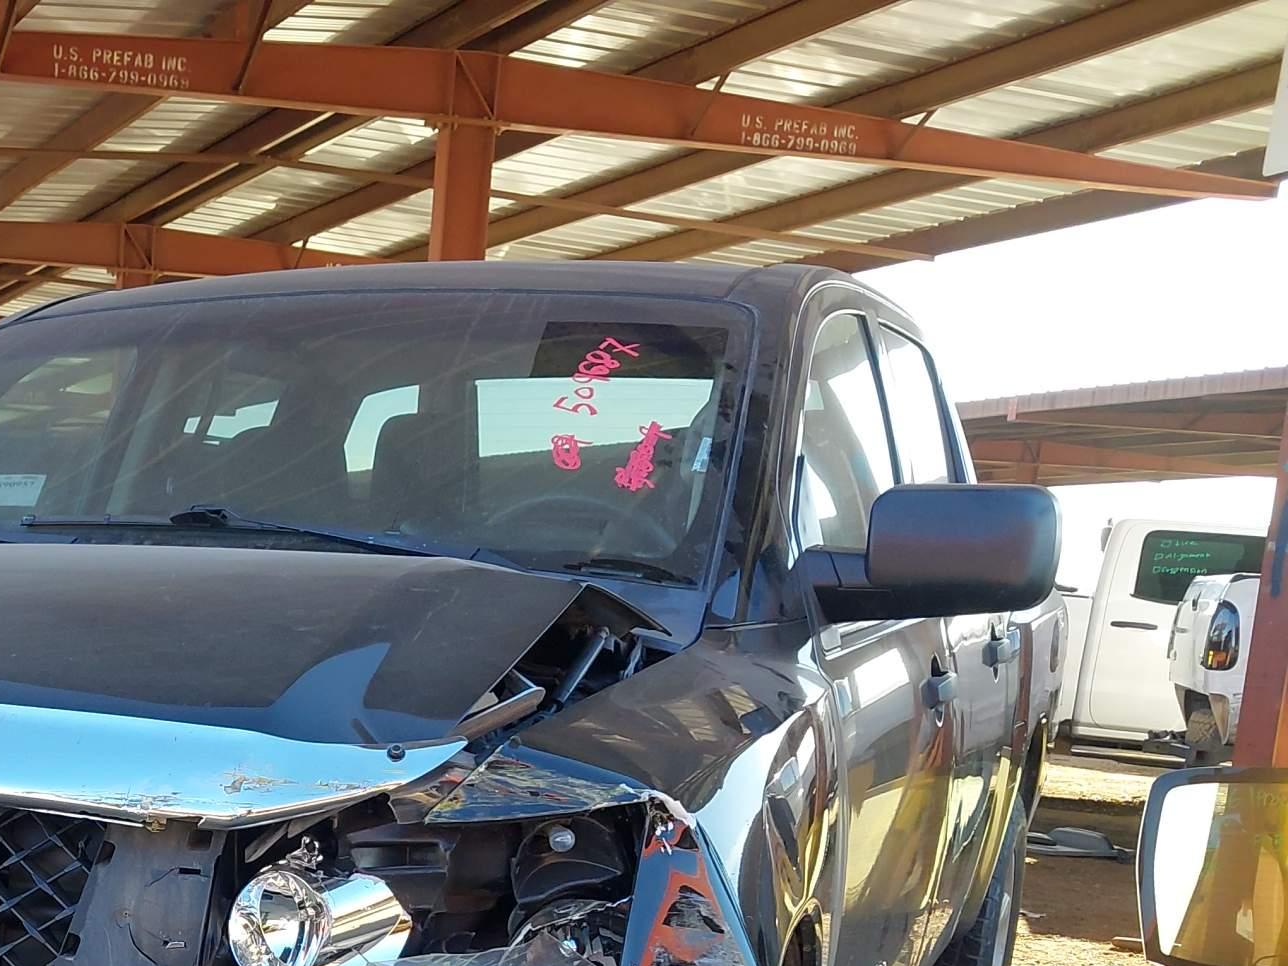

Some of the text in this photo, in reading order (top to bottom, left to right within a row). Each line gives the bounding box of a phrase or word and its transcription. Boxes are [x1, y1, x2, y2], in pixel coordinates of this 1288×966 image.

[53, 44, 83, 62] U.S.
[92, 48, 154, 69] PREFAB
[774, 118, 827, 136] PREFAB
[833, 124, 860, 140] INC.
[740, 130, 857, 156] 1-866-799-0969
